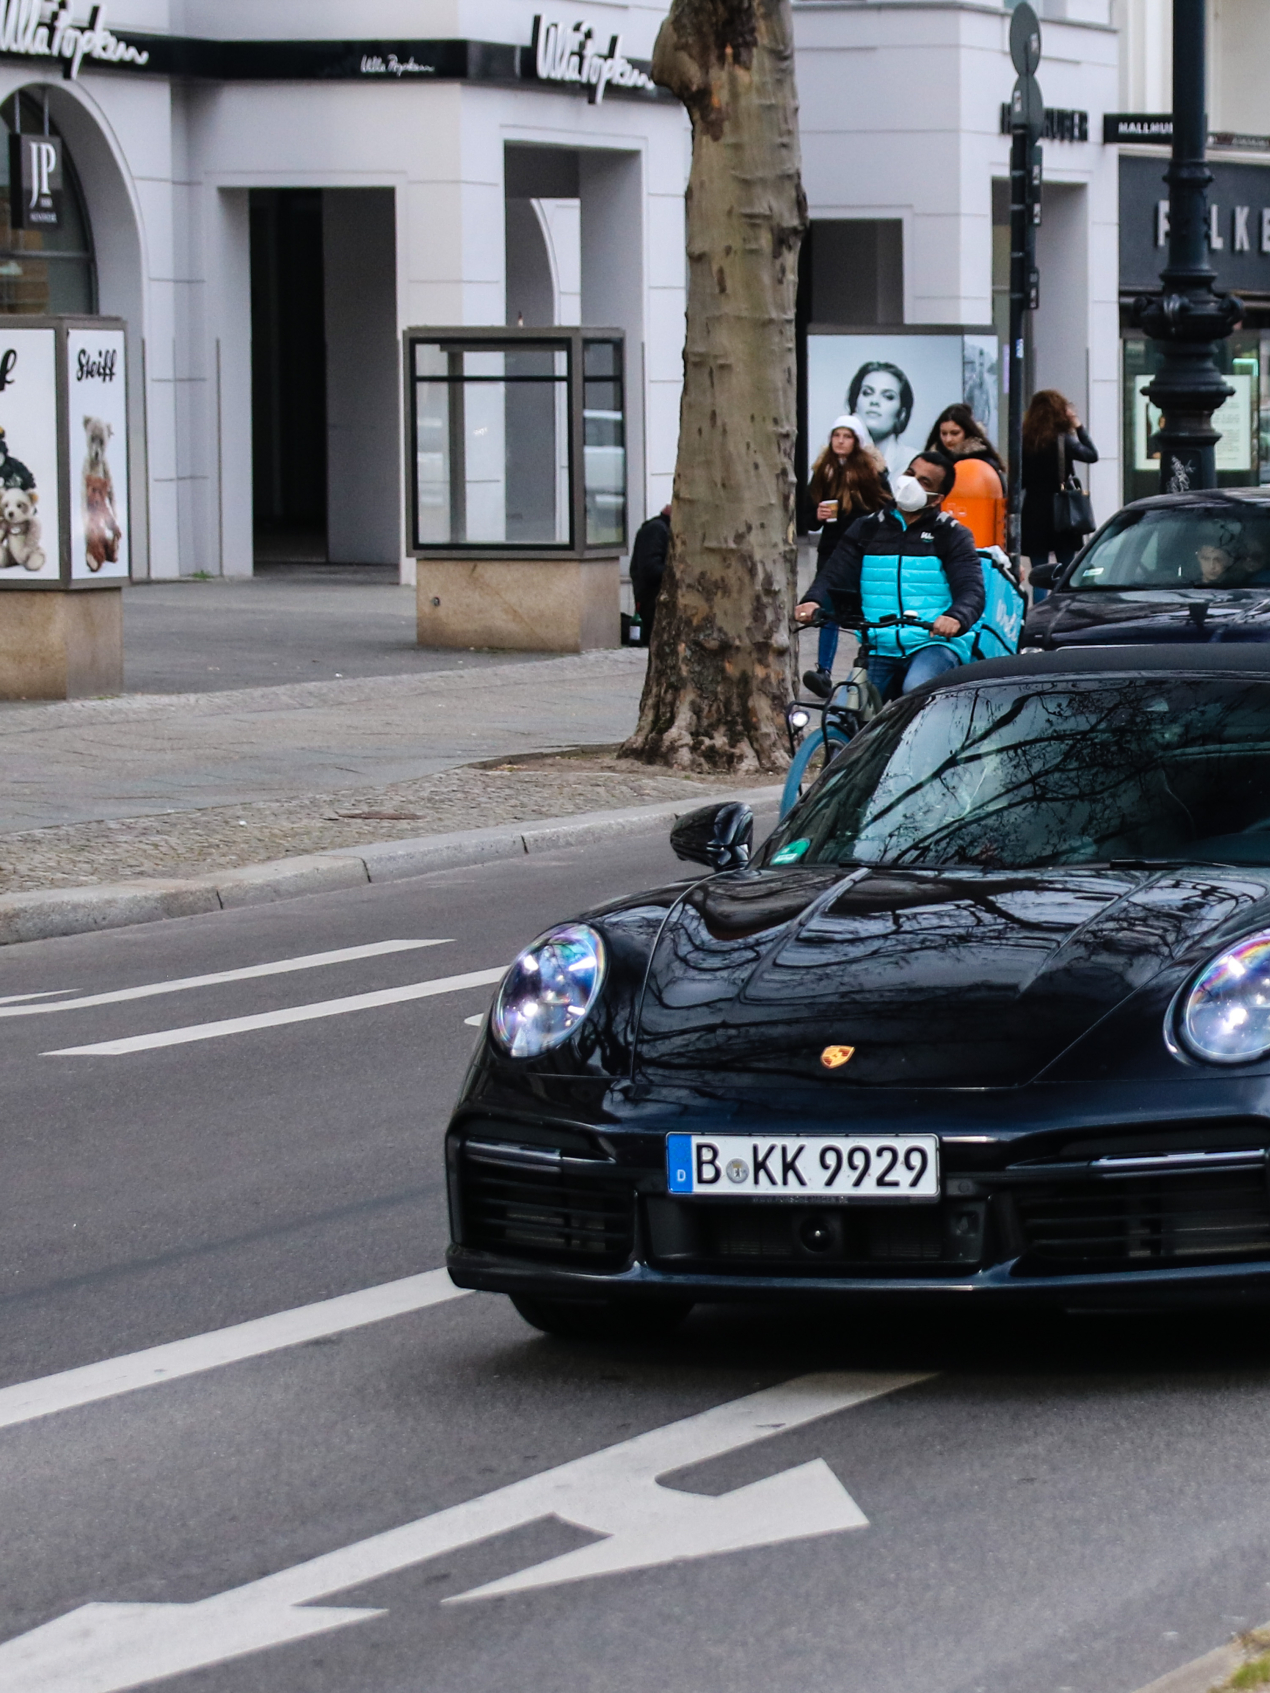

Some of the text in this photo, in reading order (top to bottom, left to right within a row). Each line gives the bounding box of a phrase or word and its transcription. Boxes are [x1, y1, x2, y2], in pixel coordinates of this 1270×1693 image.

[29, 142, 57, 209] JP
[77, 348, 117, 383] Steiff
[677, 1169, 686, 1182] D
[696, 1142, 928, 1187] B KK 9929
